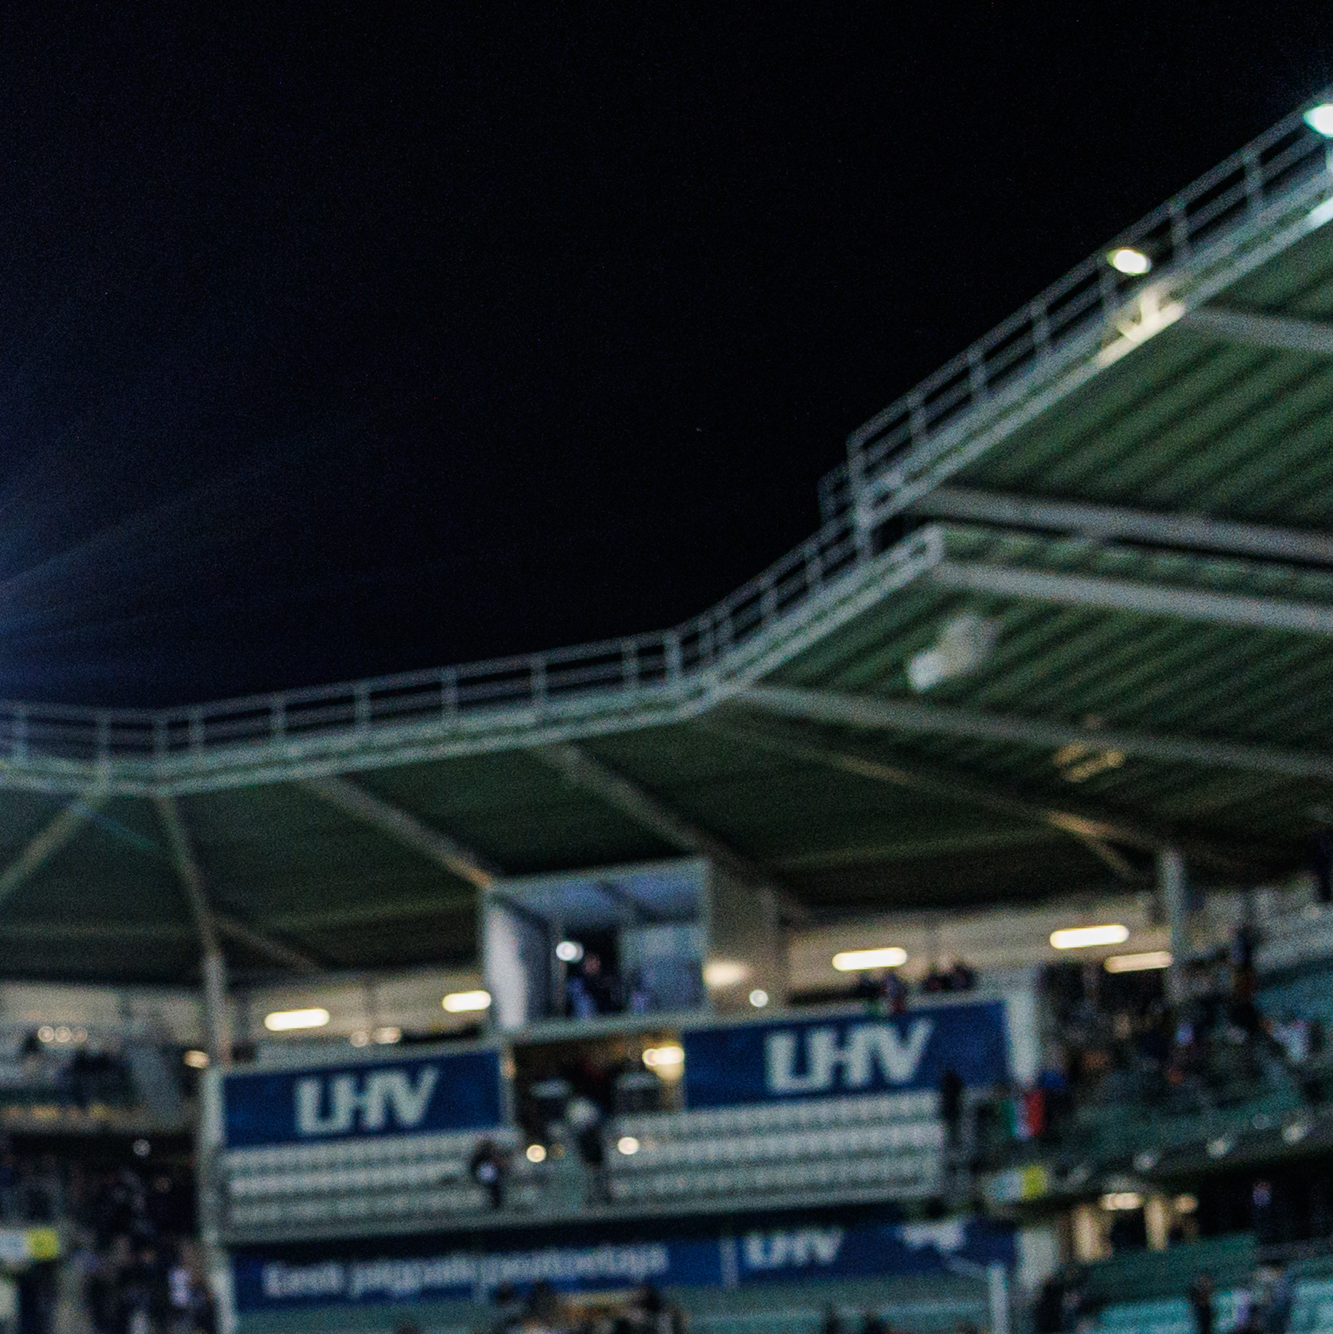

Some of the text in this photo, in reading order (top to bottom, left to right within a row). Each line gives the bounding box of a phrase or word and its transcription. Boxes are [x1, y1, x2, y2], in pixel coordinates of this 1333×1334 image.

[766, 1020, 932, 1094] LHV
[295, 1068, 438, 1134] LHV
[744, 1228, 844, 1269] LHV
